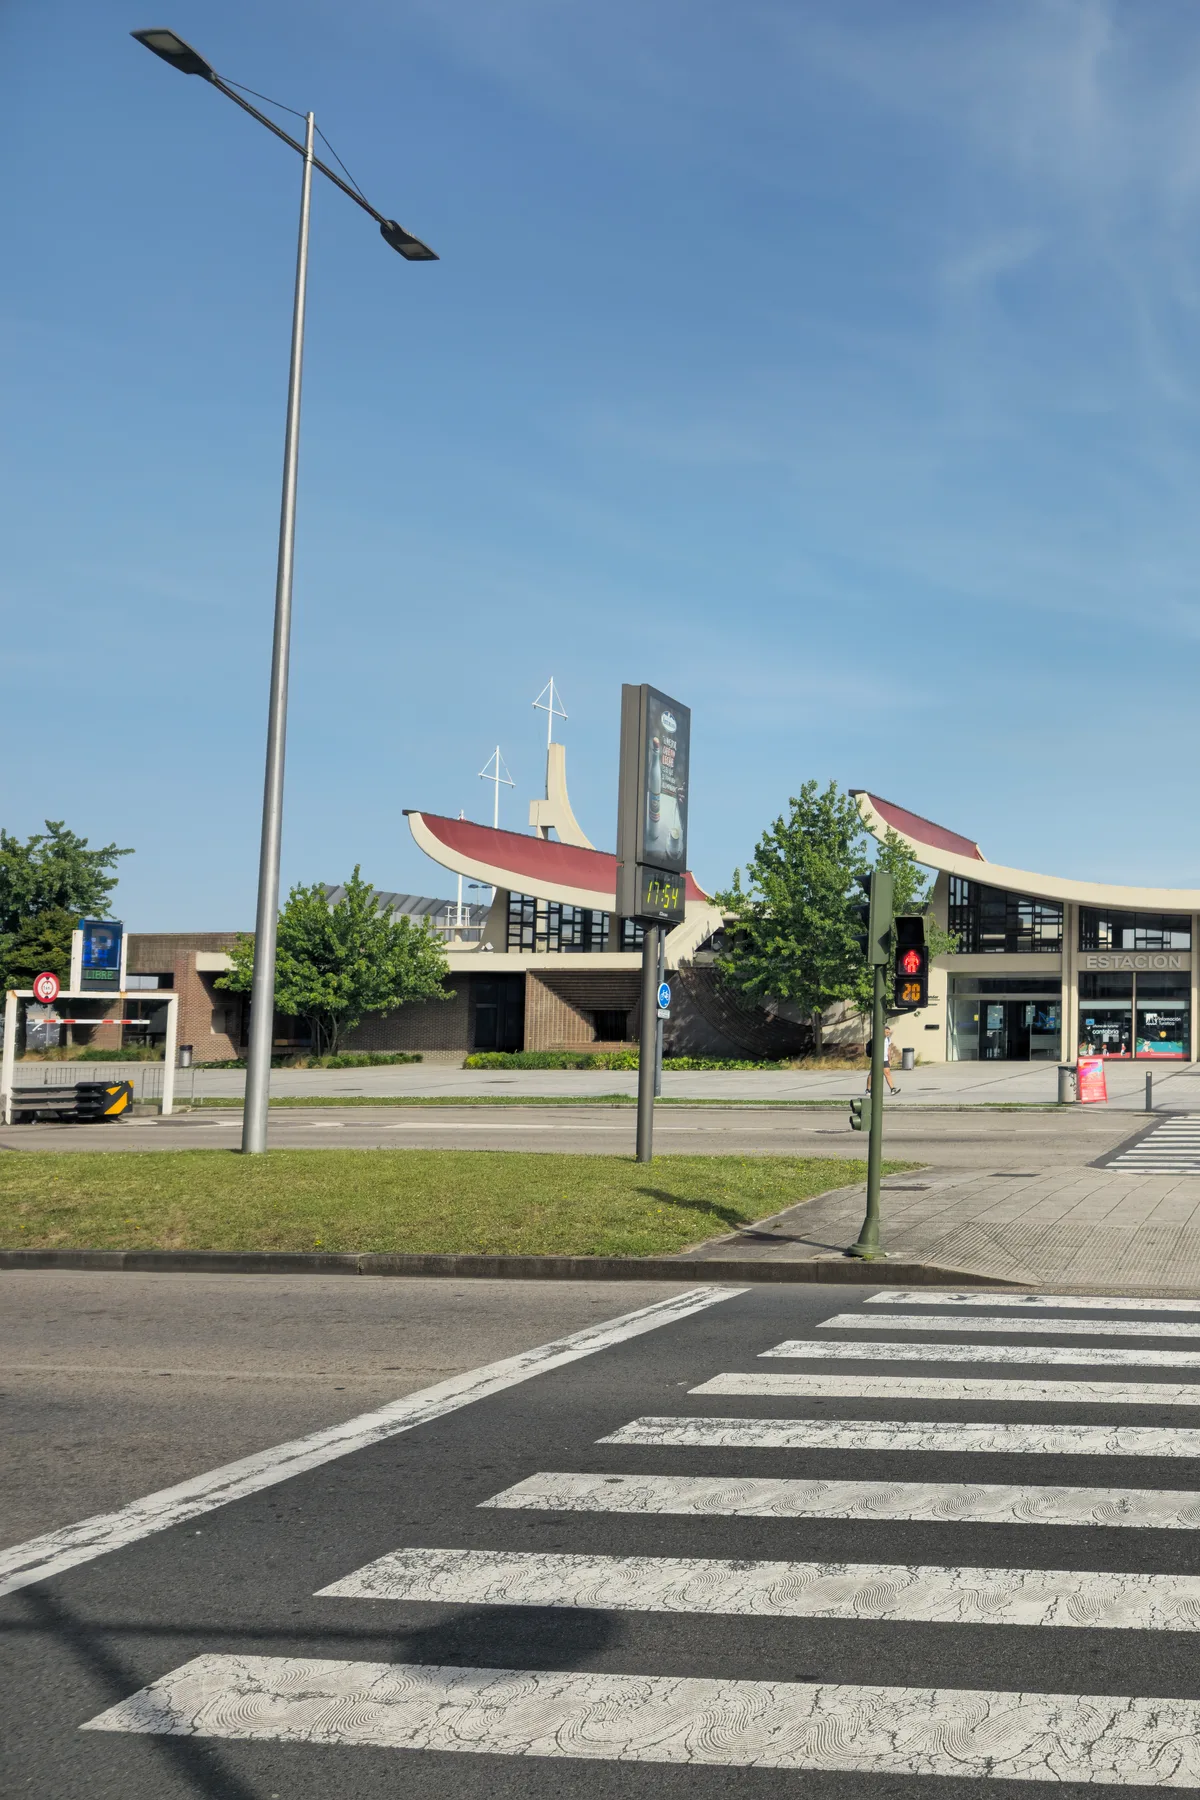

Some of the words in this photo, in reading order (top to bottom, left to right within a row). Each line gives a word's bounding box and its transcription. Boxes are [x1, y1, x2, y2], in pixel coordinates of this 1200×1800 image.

[647, 881, 679, 909] 17:54
[1086, 955, 1181, 969] ESTACION
[86, 970, 114, 979] LIBRE
[902, 983, 920, 1001] 20
